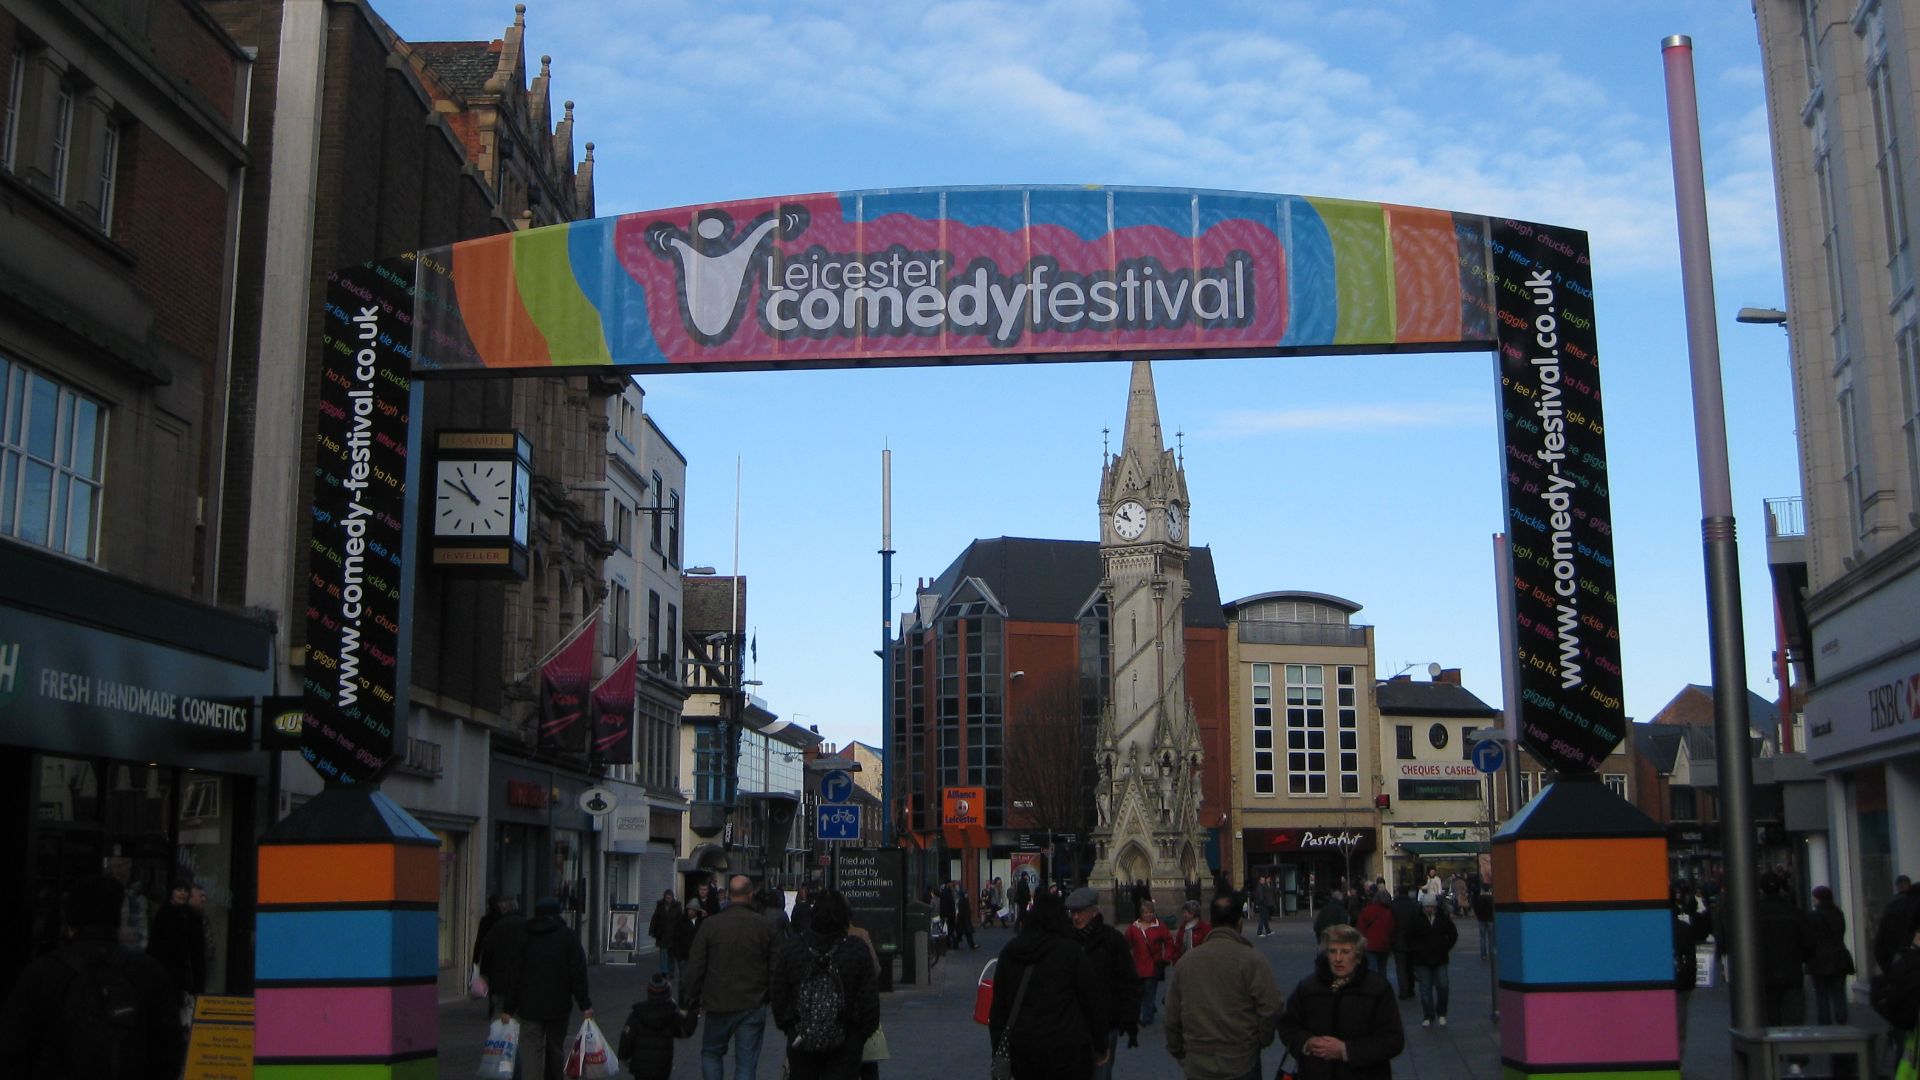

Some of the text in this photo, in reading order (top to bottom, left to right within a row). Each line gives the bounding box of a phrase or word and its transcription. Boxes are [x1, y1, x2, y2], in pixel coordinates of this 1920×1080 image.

[1537, 233, 1575, 258] chuckle
[1508, 249, 1532, 268] titter
[768, 253, 945, 291] Leicester
[341, 278, 374, 302] chuckle
[1503, 278, 1518, 293] ha
[765, 260, 1245, 341] comedyfestival
[1497, 308, 1529, 330] giggle
[1561, 308, 1590, 330] laugh
[393, 339, 413, 359] joke
[1502, 341, 1522, 360] hee
[1565, 342, 1589, 360] titter
[326, 368, 339, 382] ha
[380, 367, 411, 392] chuckle
[1513, 381, 1530, 397] tee
[1576, 379, 1590, 394] ha
[320, 399, 347, 420] giggle
[1515, 415, 1539, 435] joke
[1589, 419, 1604, 435] ha
[322, 435, 340, 453] hee
[375, 432, 397, 449] titter
[1506, 443, 1543, 470] chuckle
[385, 472, 398, 488] ha
[1525, 269, 1582, 689] www.comedy-festival.co.uk
[1593, 481, 1608, 497] ha
[339, 305, 379, 707] www.comedy-festival.co.uk
[442, 551, 501, 561] JEWELLER
[1591, 550, 1613, 568] hee
[370, 644, 396, 668] laugh
[1530, 653, 1545, 669] ha
[40, 668, 247, 733] FRESH HANDMADE COSMETICS
[314, 682, 332, 700] hee
[372, 684, 395, 703] titter
[1590, 686, 1620, 710] laugh
[1522, 687, 1617, 743] giggle ha ha titter
[1869, 679, 1904, 732] HSBC
[364, 714, 377, 729] ha
[377, 722, 391, 738] ha
[1528, 722, 1549, 742] hee
[1551, 738, 1584, 760] giggle
[316, 759, 338, 776] joke
[1401, 765, 1478, 776] CHEQUES CASHED
[947, 790, 976, 799] Alliance
[945, 815, 978, 824] Leicester
[1423, 829, 1466, 841] Mallard
[860, 856, 875, 865] and
[869, 867, 879, 878] by
[857, 878, 866, 887] 15
